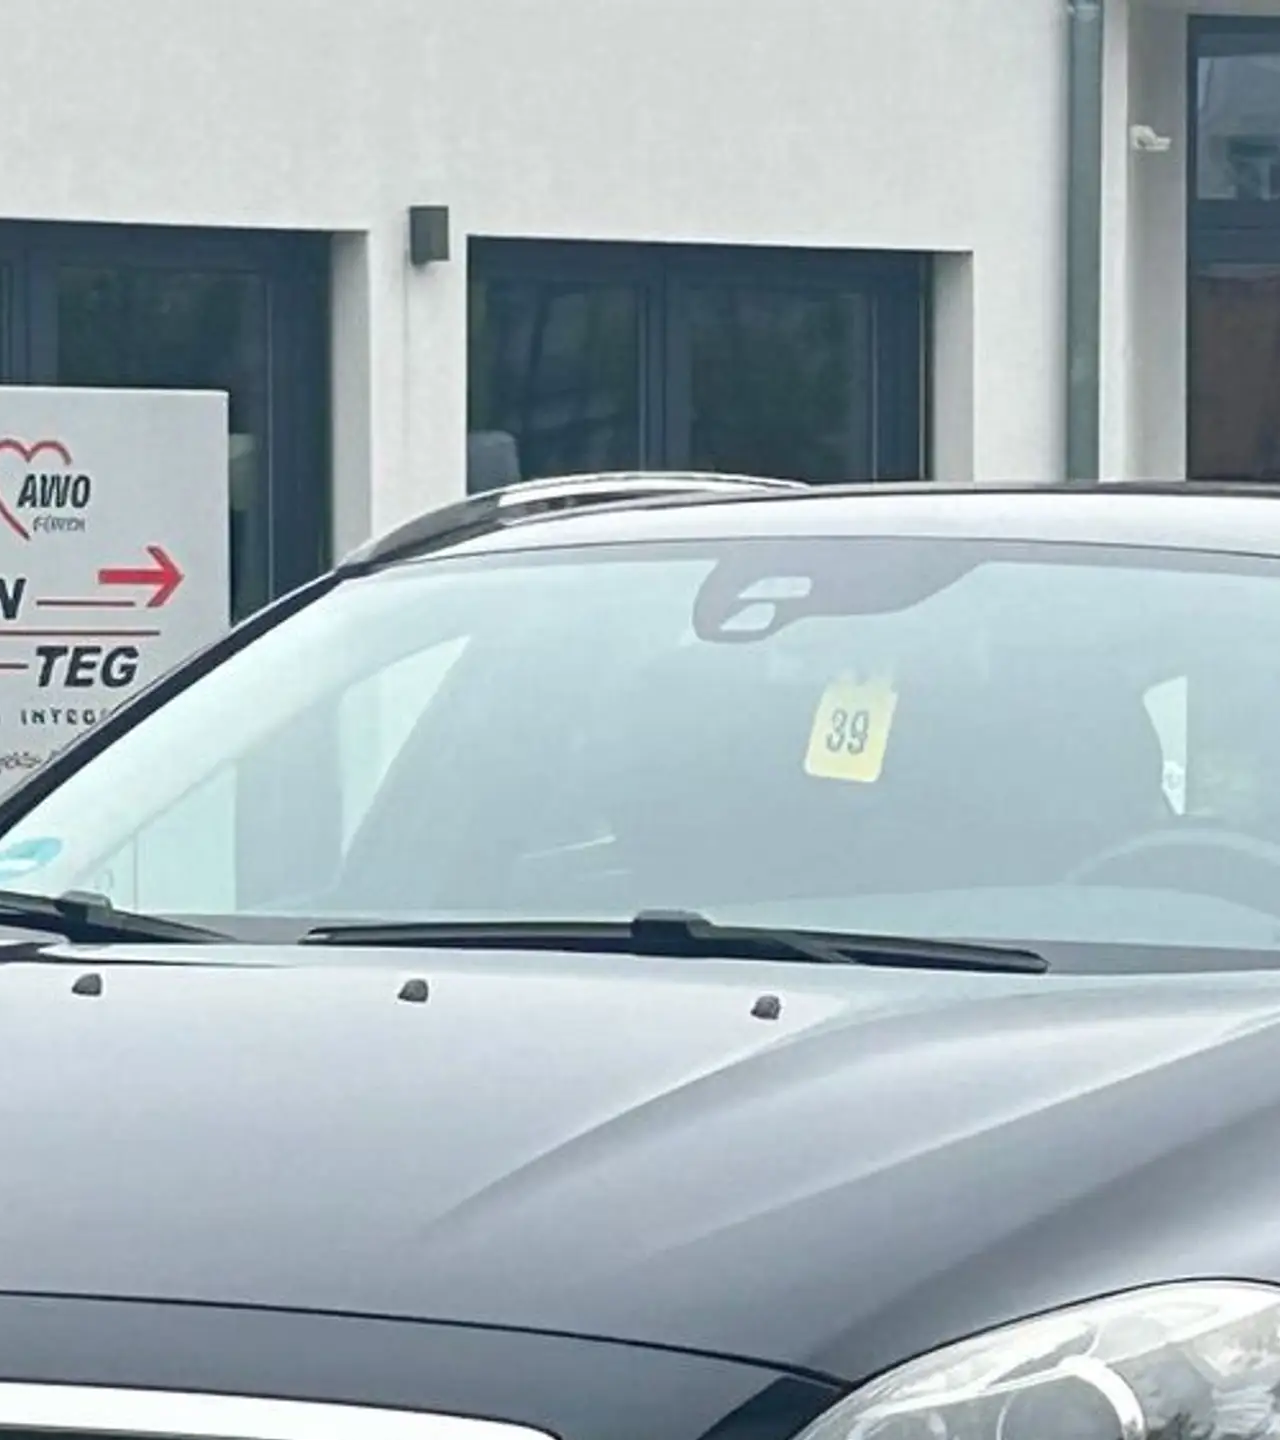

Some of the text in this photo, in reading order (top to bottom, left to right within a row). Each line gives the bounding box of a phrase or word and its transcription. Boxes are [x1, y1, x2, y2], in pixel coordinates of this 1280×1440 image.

[17, 473, 91, 508] AWO
[35, 645, 139, 688] TEG
[825, 708, 869, 755] 39
